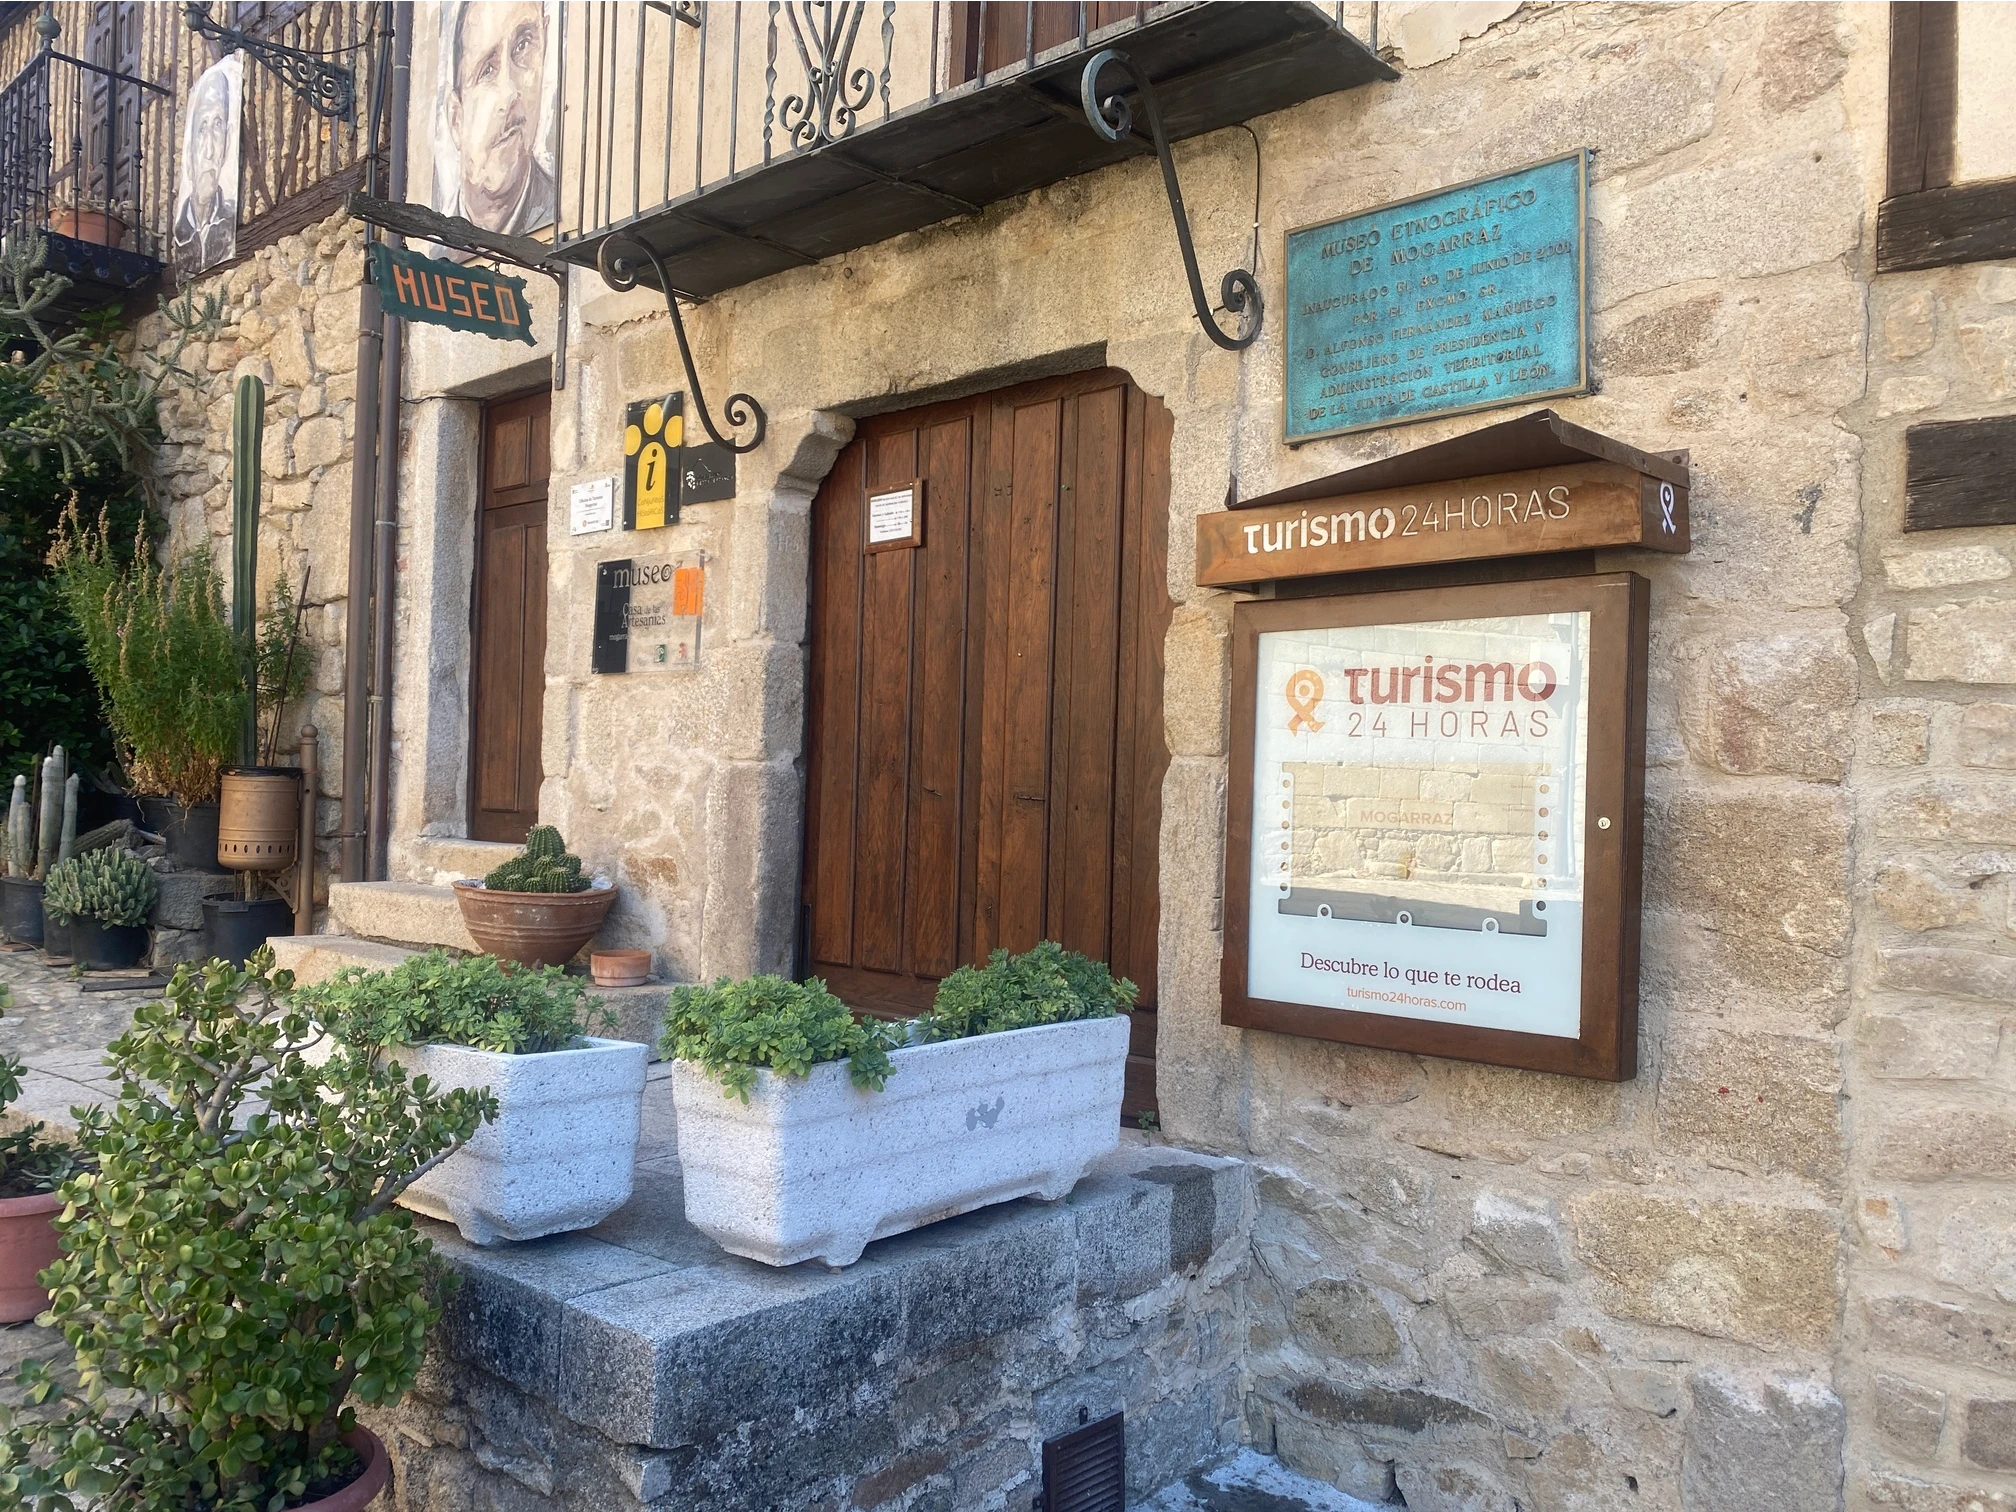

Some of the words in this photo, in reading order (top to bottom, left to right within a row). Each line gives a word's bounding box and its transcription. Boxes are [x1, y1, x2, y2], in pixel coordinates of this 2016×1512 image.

[1321, 229, 1381, 259] MUSEO
[1391, 188, 1537, 241] ETNOGRÁFICO
[1350, 256, 1373, 277] DE
[1391, 224, 1502, 266] MOGARRAZ
[392, 263, 520, 326] MUSEO
[1303, 285, 1389, 315] INAUGURADO
[1396, 281, 1413, 295] EL
[1446, 268, 1464, 282] DE
[1469, 255, 1511, 276] JUNIO
[1513, 251, 1531, 265] DE
[1352, 311, 1377, 326] POR
[1389, 306, 1405, 318] EL
[1320, 352, 1399, 378] CONSEJERO
[1407, 345, 1425, 361] DE
[1432, 324, 1527, 356] PRESIDENCIA
[1535, 320, 1546, 334] Y
[1324, 333, 1385, 356] ALFONSO
[1309, 406, 1327, 420] DE
[1330, 401, 1348, 416] LA
[1354, 393, 1396, 412] JUNTA
[1398, 389, 1416, 404] DE
[1422, 375, 1489, 399] CASTILLA
[1494, 371, 1504, 385] Y
[1320, 364, 1433, 399] ADMINISTRACIÓN
[1444, 344, 1546, 374] TERRITORIAL
[1344, 655, 1557, 705] turismo
[1348, 712, 1387, 738] 24
[1411, 710, 1549, 738] HORAS
[1360, 810, 1453, 826] MOGARRAZ
[1301, 952, 1379, 977] Descubre
[1384, 961, 1400, 979] lo
[1405, 968, 1439, 986] que
[1444, 971, 1461, 986] te
[1467, 974, 1521, 994] rodea
[1347, 986, 1467, 1012] turismo24horas.com
